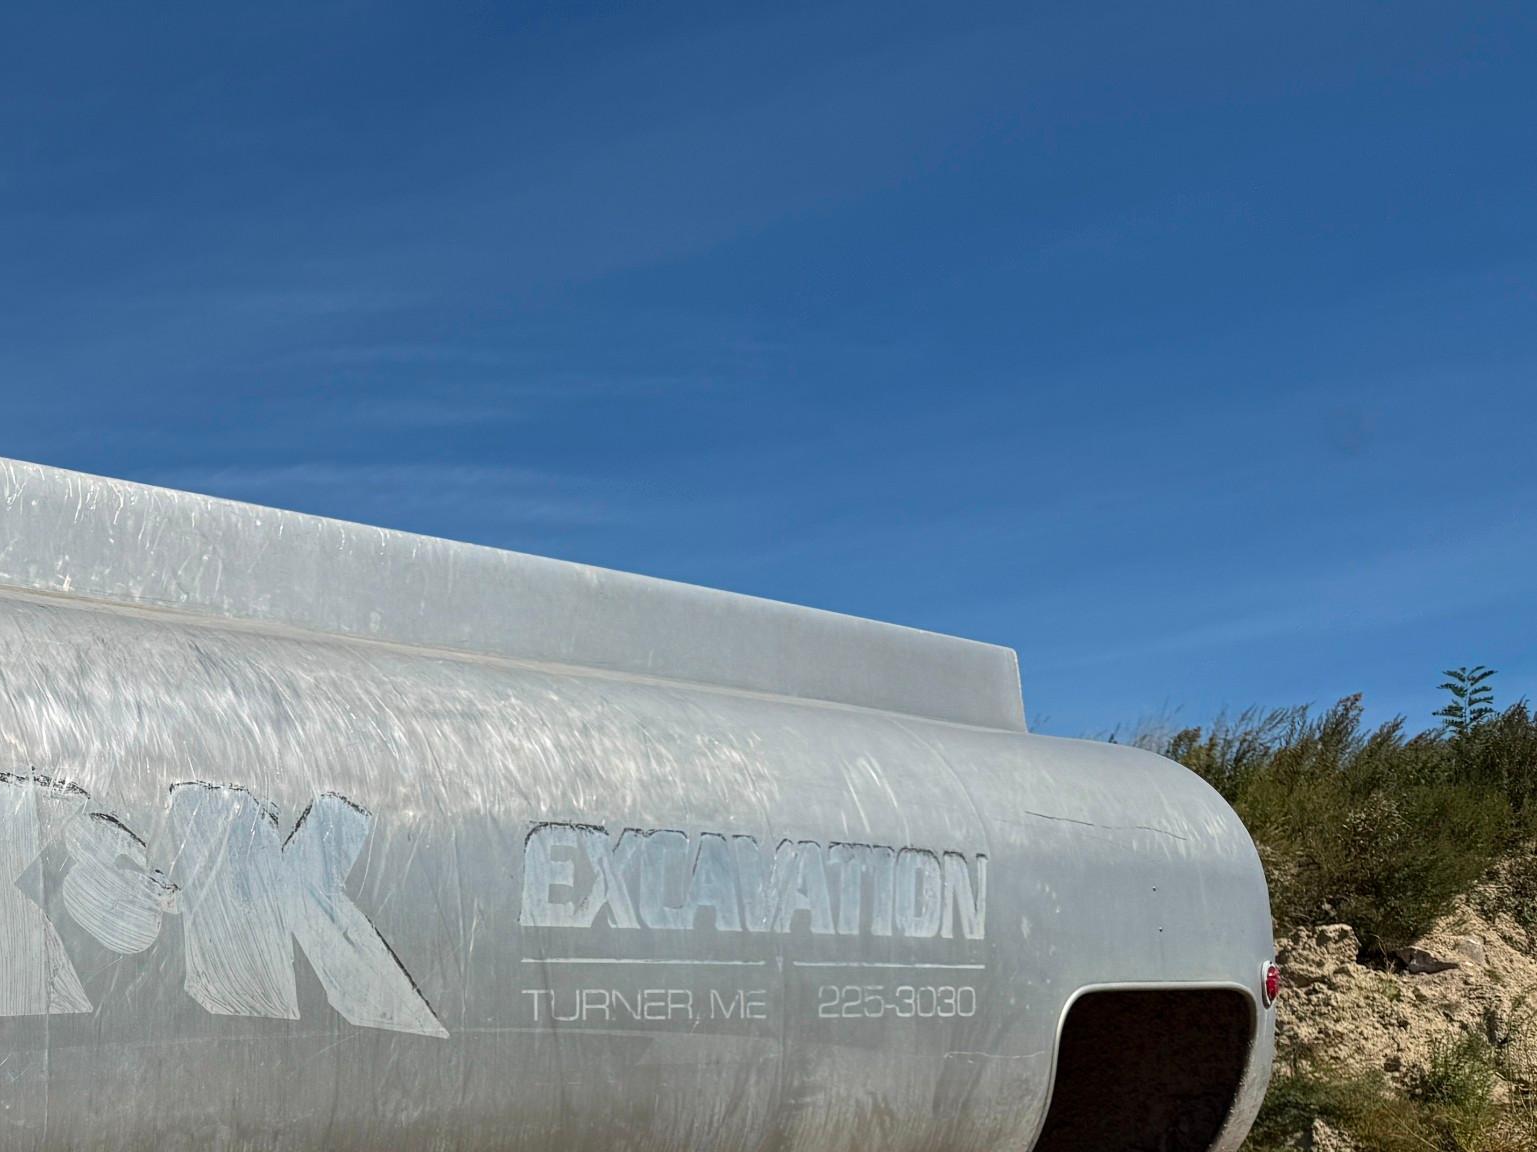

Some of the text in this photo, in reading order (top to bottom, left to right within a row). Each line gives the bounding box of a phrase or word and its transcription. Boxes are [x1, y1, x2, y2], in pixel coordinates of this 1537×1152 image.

[519, 821, 987, 940] EXCAVATION
[710, 990, 767, 1020] ME
[818, 985, 977, 1018] 225-3030
